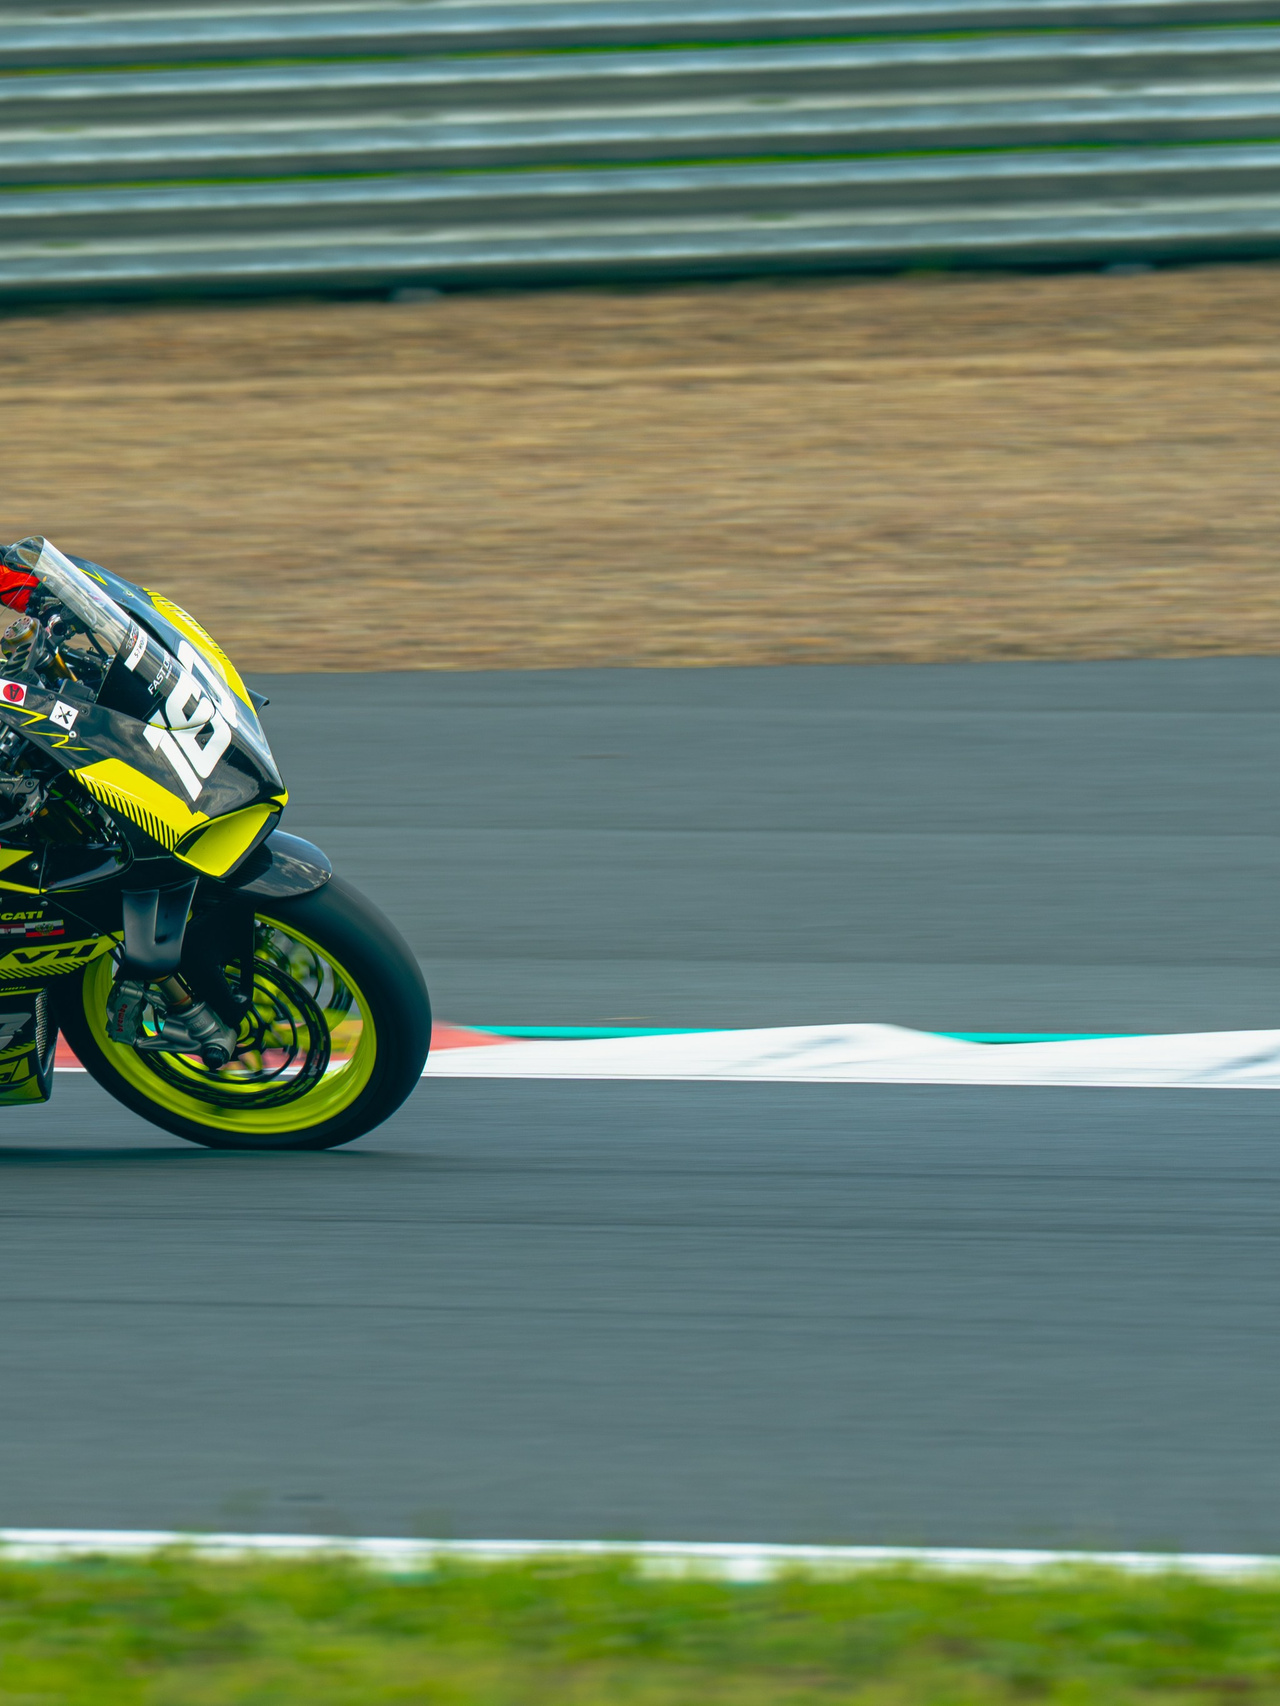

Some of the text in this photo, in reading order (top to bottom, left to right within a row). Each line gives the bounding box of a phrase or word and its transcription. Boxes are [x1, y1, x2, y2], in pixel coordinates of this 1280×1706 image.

[9, 685, 20, 700] A
[147, 665, 167, 695] FAST
[142, 640, 238, 801] 160
[12, 942, 99, 964] V4
[115, 1003, 128, 1033] brembo
